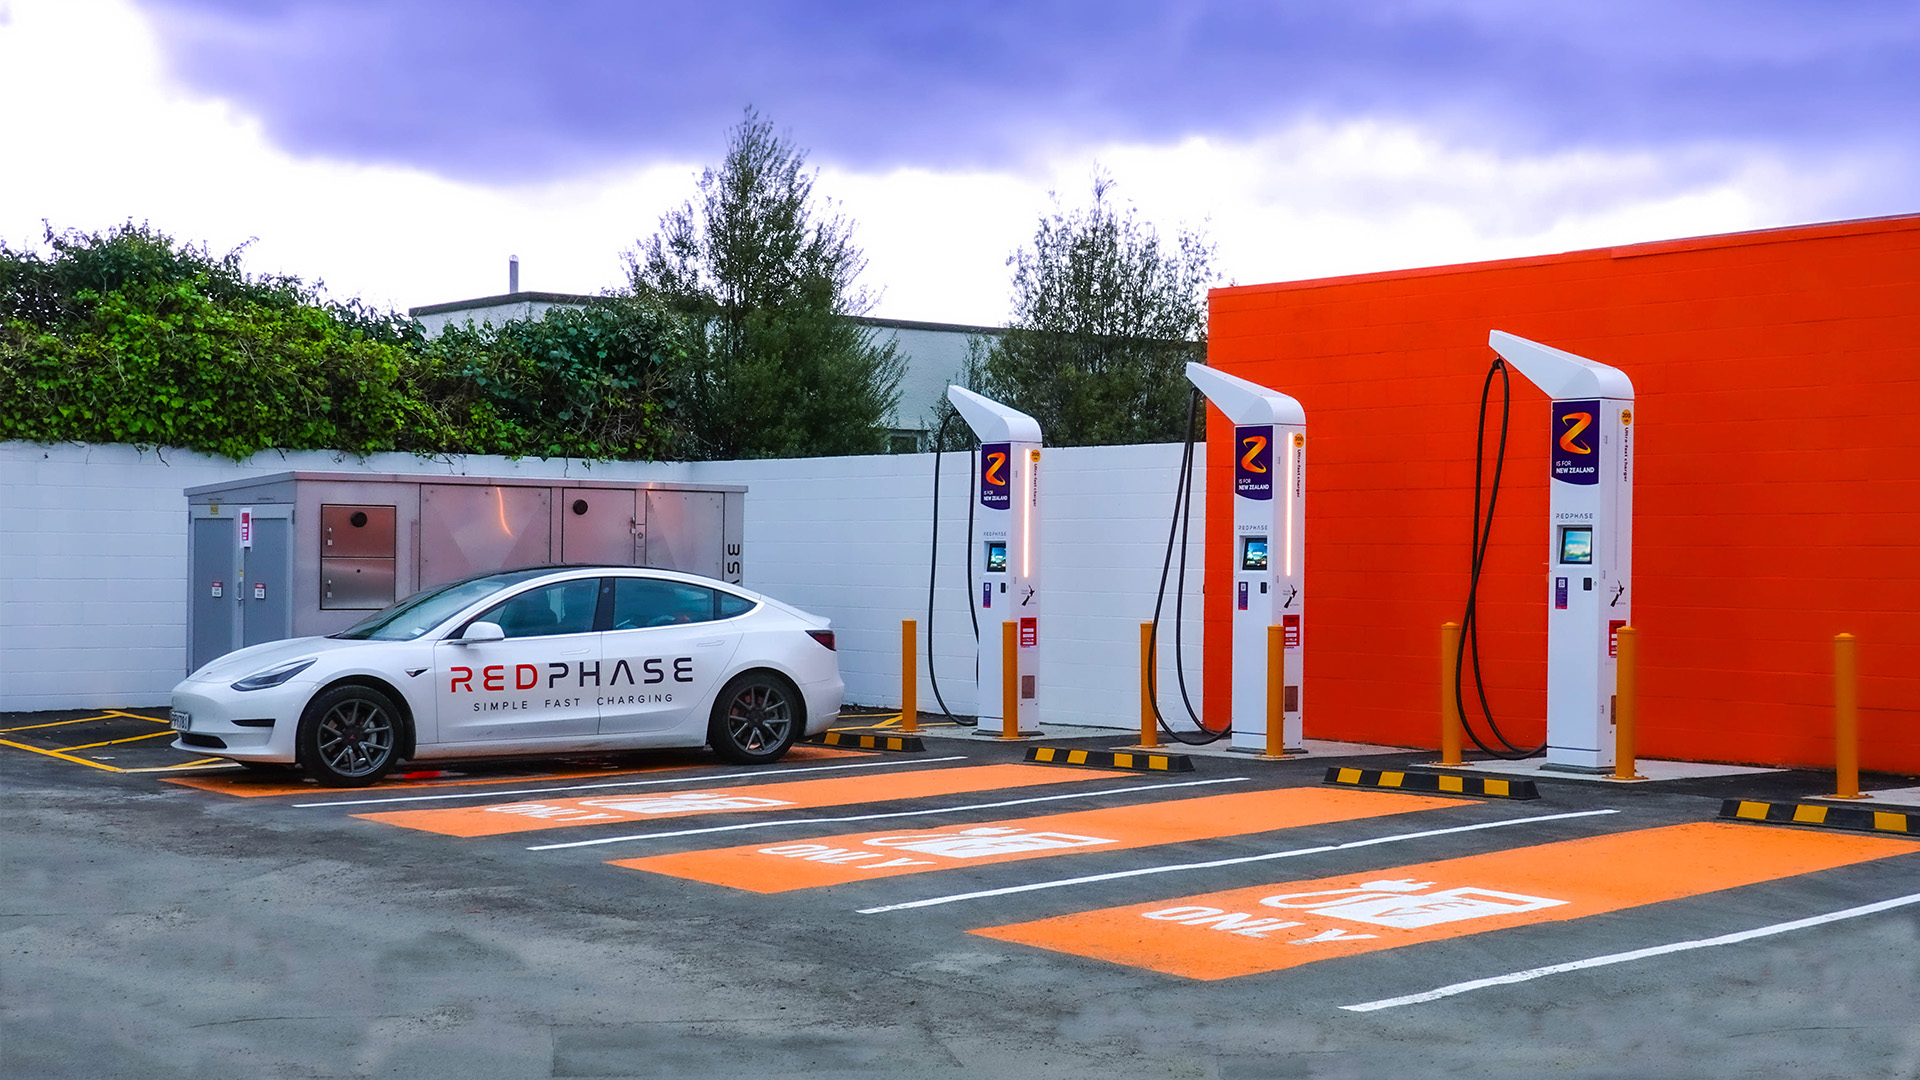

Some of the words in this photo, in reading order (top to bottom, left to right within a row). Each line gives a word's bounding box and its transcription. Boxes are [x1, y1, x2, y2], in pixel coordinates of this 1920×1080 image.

[1560, 412, 1592, 454] Z
[986, 452, 1006, 486] Z
[1241, 436, 1267, 474] Z
[450, 657, 693, 692] REDPHASE
[474, 700, 528, 712] SIMPLE
[545, 698, 581, 708] FAST
[597, 694, 673, 706] CHARGING
[485, 804, 624, 822] ONLY
[758, 844, 937, 869] ONLY
[1141, 906, 1380, 946] ONLY
